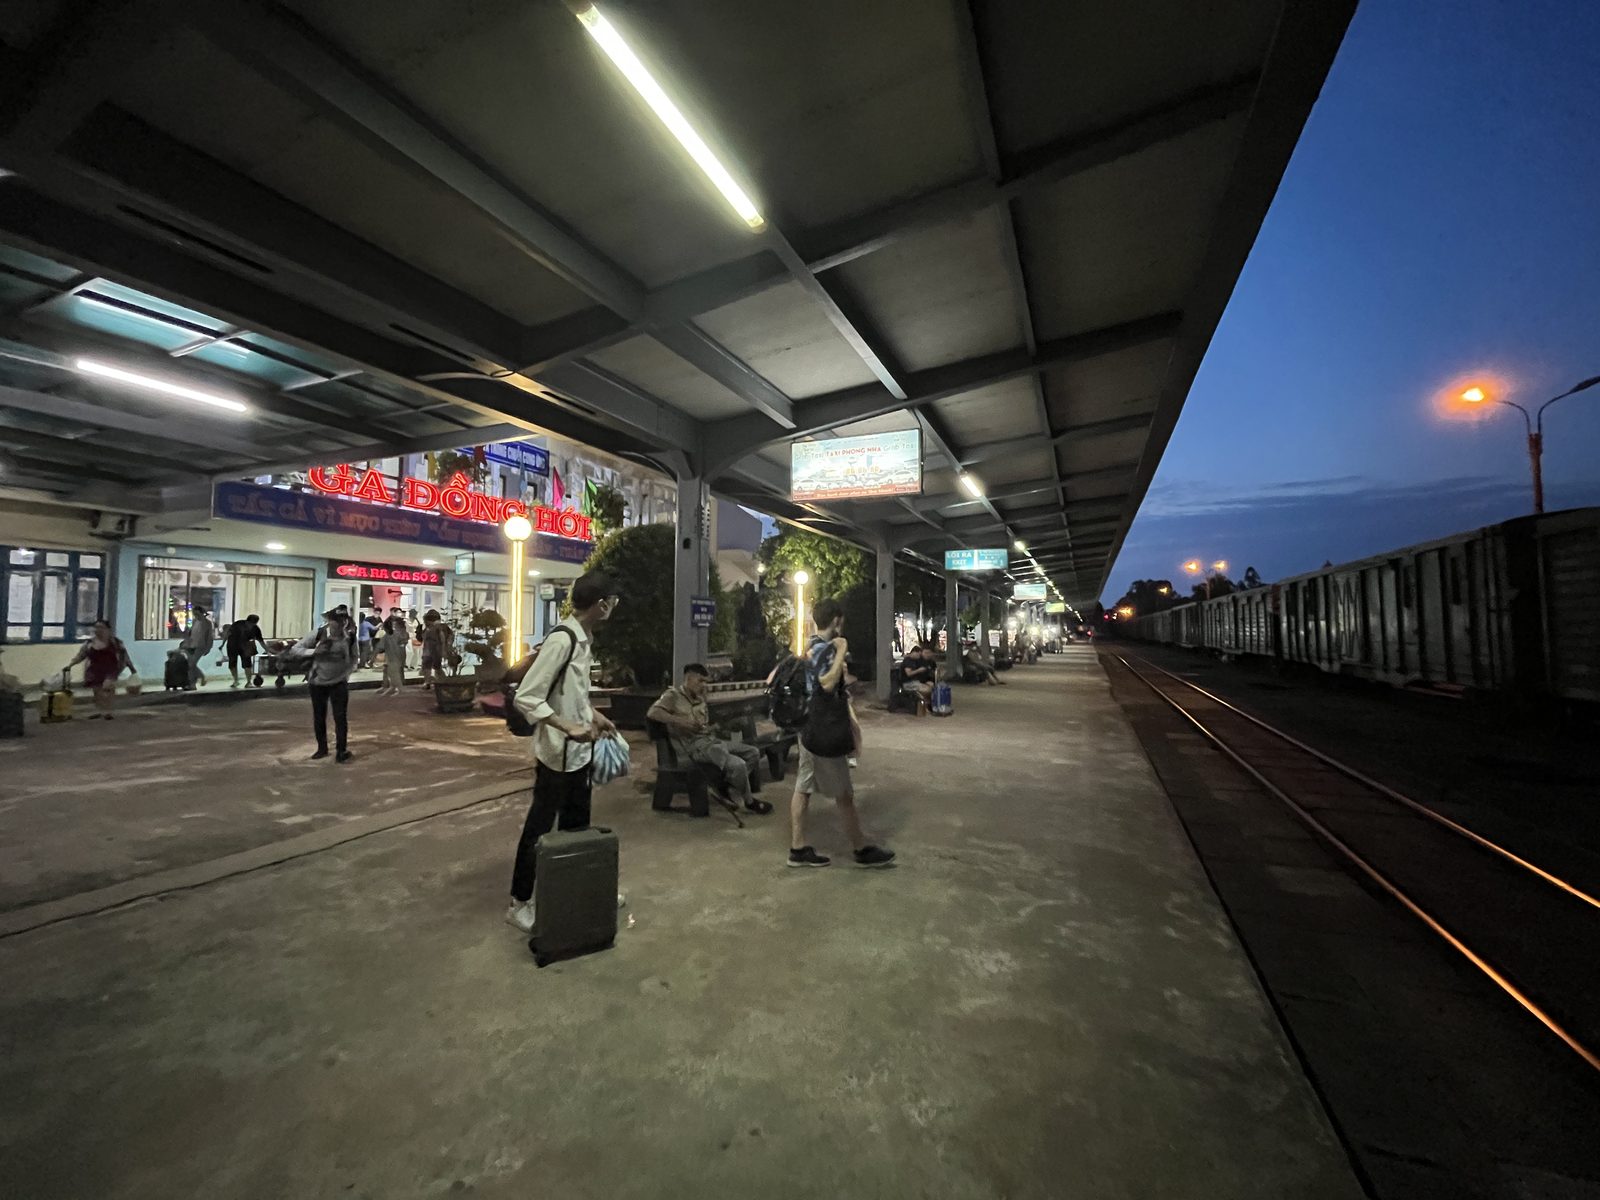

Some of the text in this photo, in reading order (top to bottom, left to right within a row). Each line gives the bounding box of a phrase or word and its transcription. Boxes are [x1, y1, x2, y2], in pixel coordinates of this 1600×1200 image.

[308, 463, 393, 503] GA
[403, 471, 528, 523] ĐỒNG
[535, 505, 593, 541] HỚI
[370, 568, 388, 579] RA
[391, 570, 410, 581] GA
[412, 569, 428, 582] SỐ
[430, 573, 437, 582] 2
